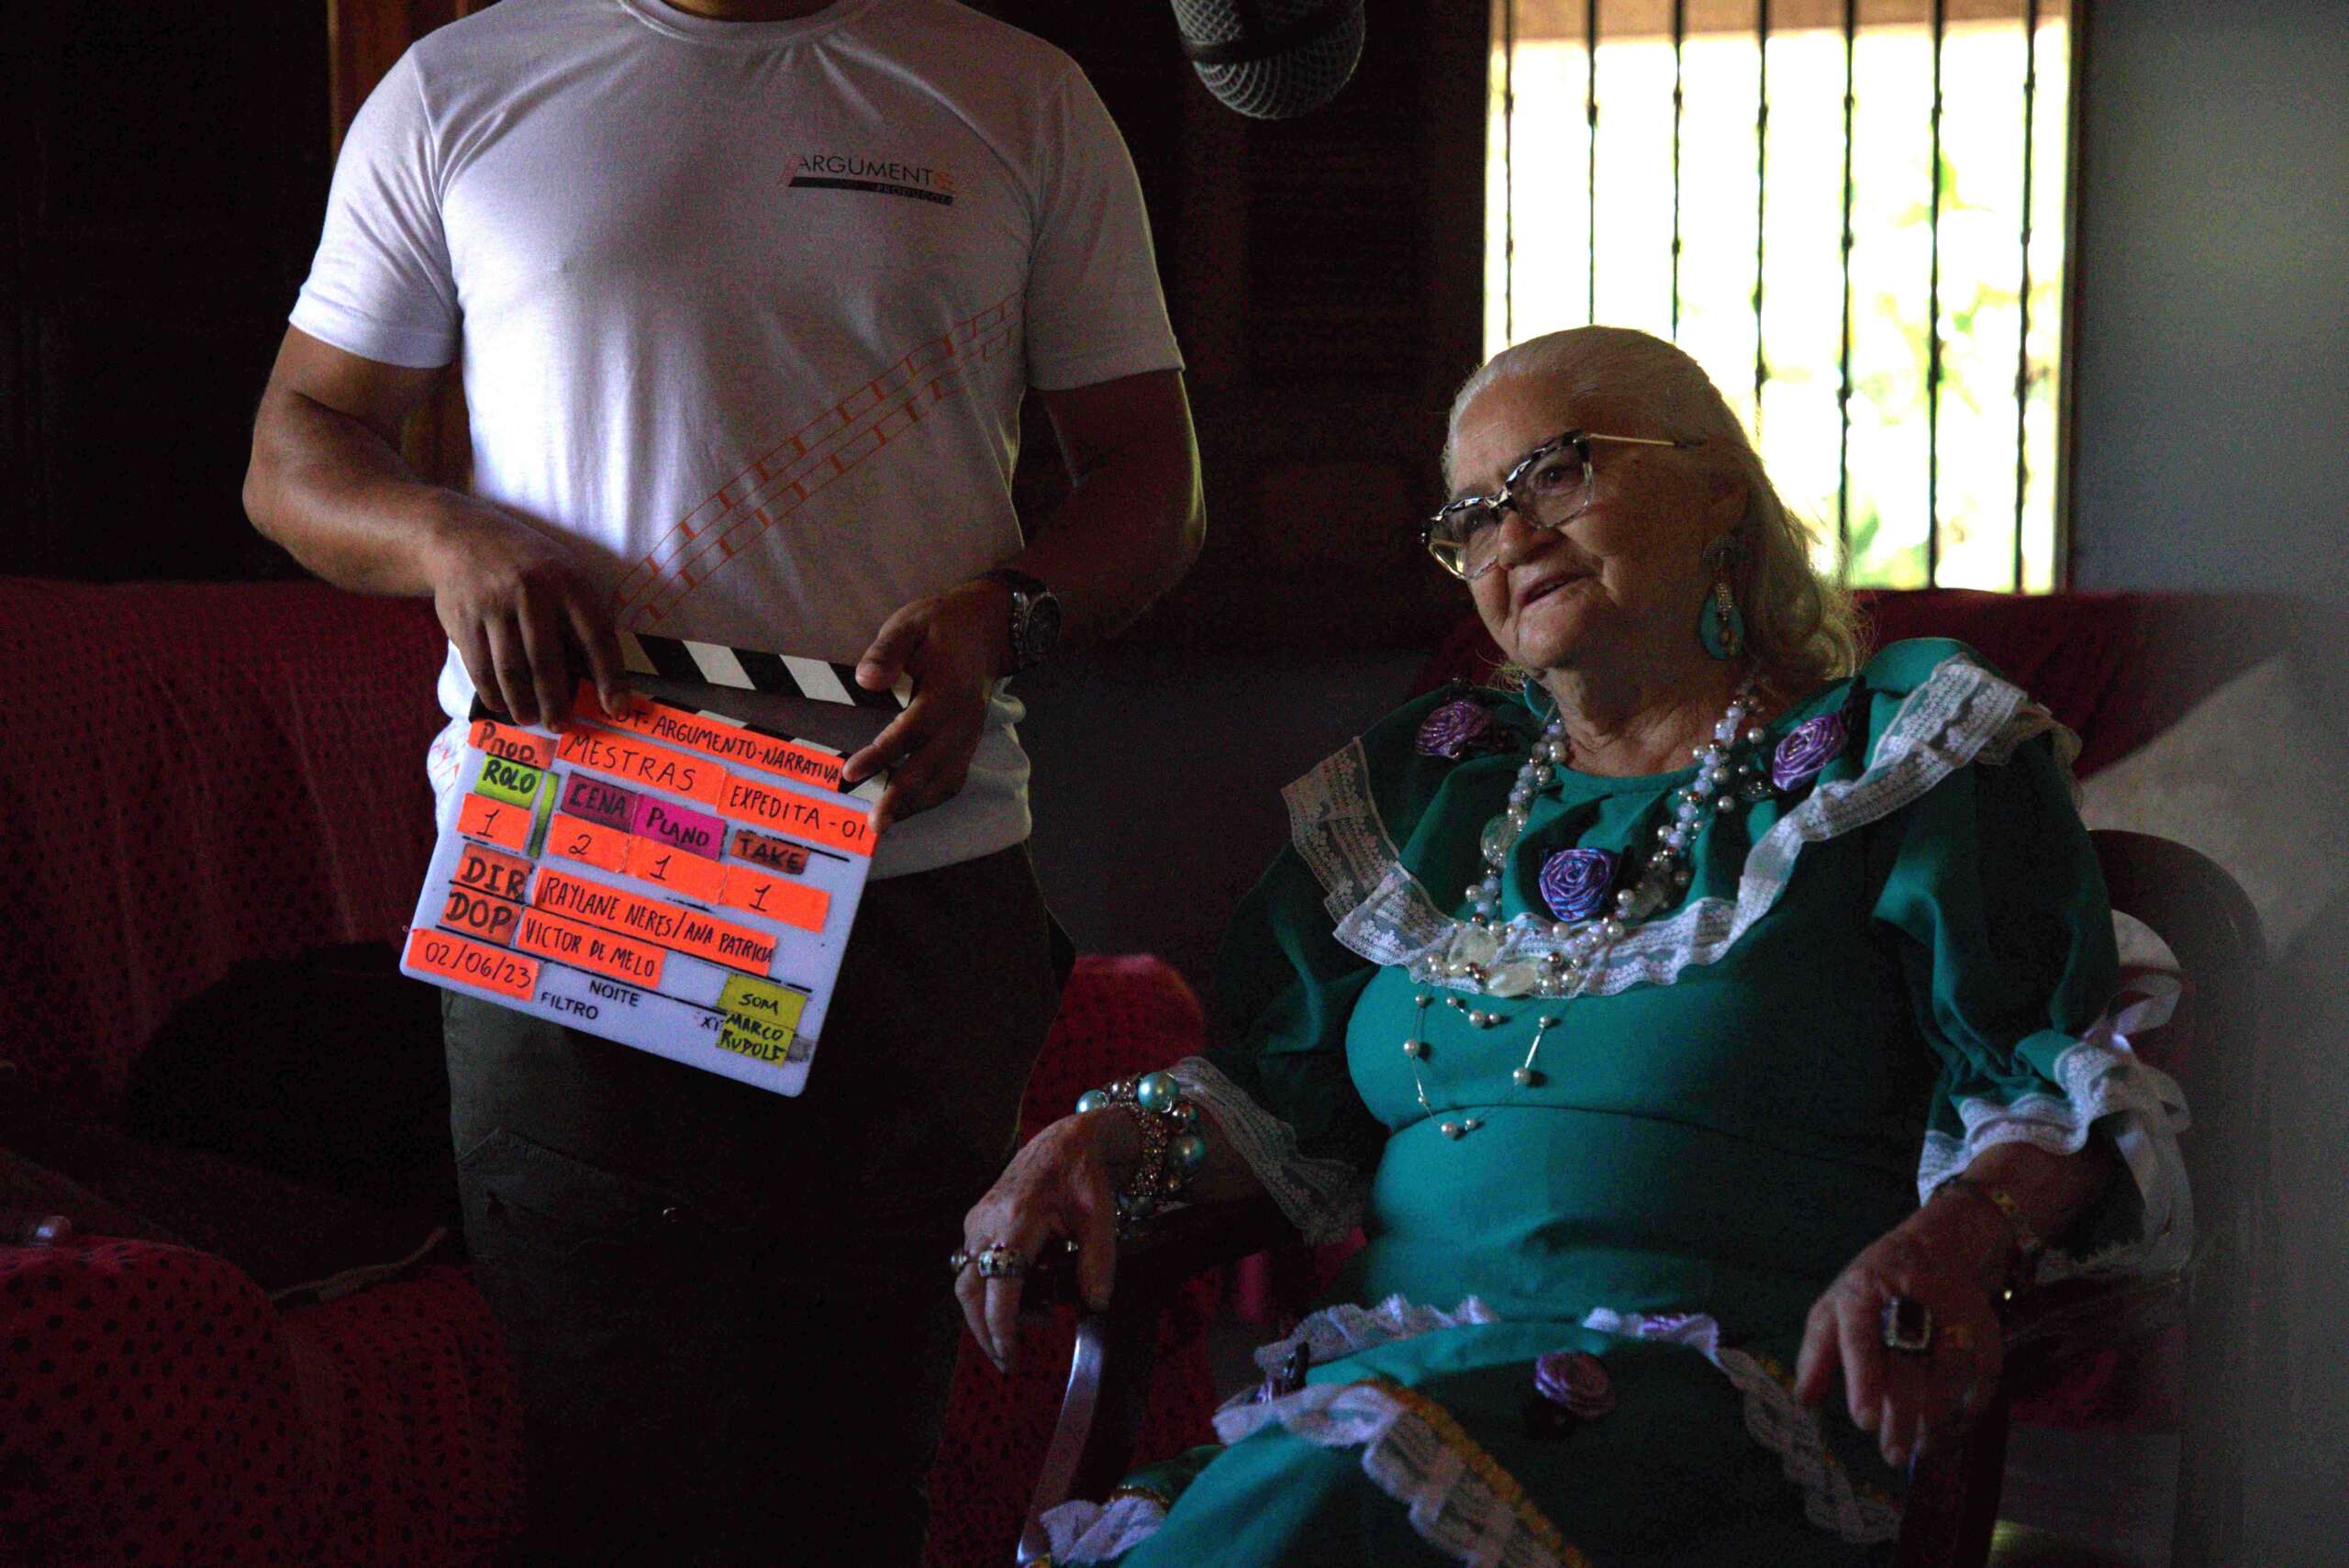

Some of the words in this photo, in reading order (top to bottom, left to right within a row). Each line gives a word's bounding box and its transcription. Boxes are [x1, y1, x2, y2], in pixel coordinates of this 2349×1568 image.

[563, 735, 696, 792] MESTRAS
[651, 715, 839, 784] ARGUMENTO-NARRATIVA
[482, 759, 537, 795] ROLO
[568, 783, 627, 818] CENA
[729, 785, 819, 830] EXPEDITA
[476, 808, 500, 839] 1
[645, 806, 710, 848] PLANO
[568, 833, 593, 855] 2
[739, 836, 801, 870] TAKE
[462, 857, 526, 904] DIR
[649, 854, 673, 881] 1
[446, 891, 512, 933] DOP
[748, 884, 772, 912] 1
[541, 876, 620, 921] RAYLANE
[718, 932, 774, 963] PATRICIA
[425, 932, 532, 989] 02/06/23
[526, 917, 582, 955] VICTOR
[589, 939, 606, 962] DE
[609, 947, 655, 978] MELO
[540, 991, 599, 1020] FILTRO
[589, 979, 640, 1007] NOITE
[738, 993, 779, 1016] SOM
[725, 1013, 785, 1041] MARCO
